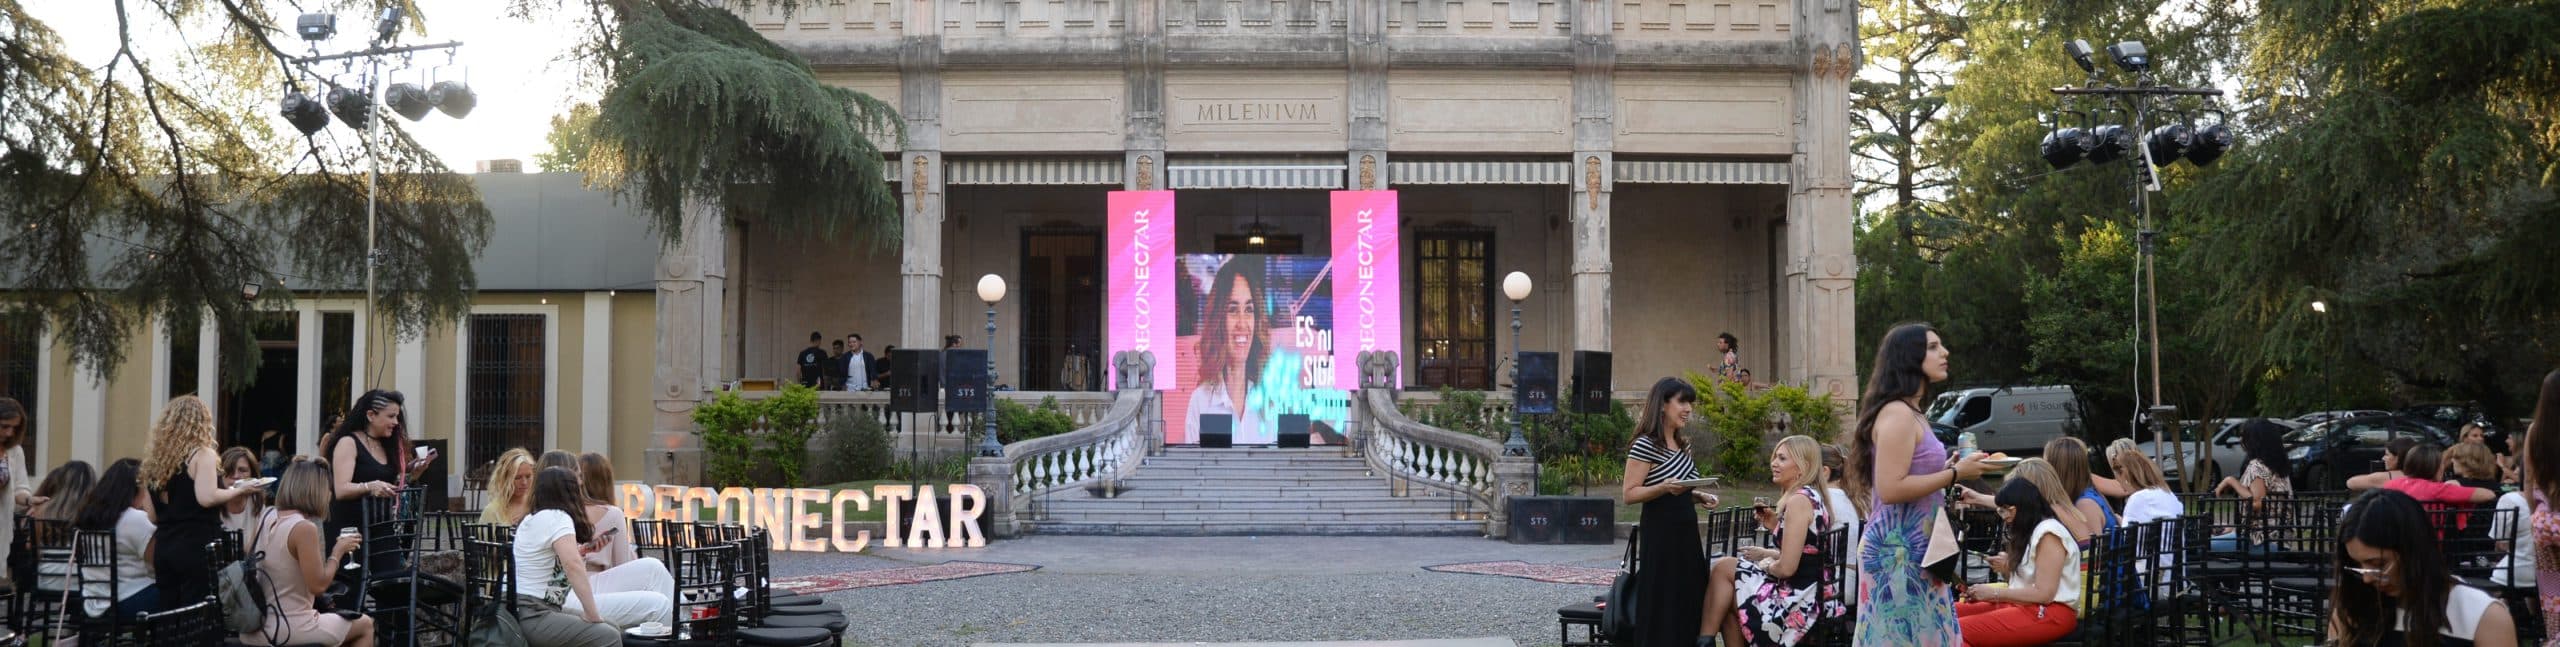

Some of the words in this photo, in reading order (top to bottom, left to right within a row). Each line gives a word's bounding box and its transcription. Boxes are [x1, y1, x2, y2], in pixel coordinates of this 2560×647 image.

[1197, 103, 1318, 121] MILENIVM
[1295, 315, 1315, 348] ES
[1530, 517, 1548, 526] STS
[1581, 517, 1598, 526] STS
